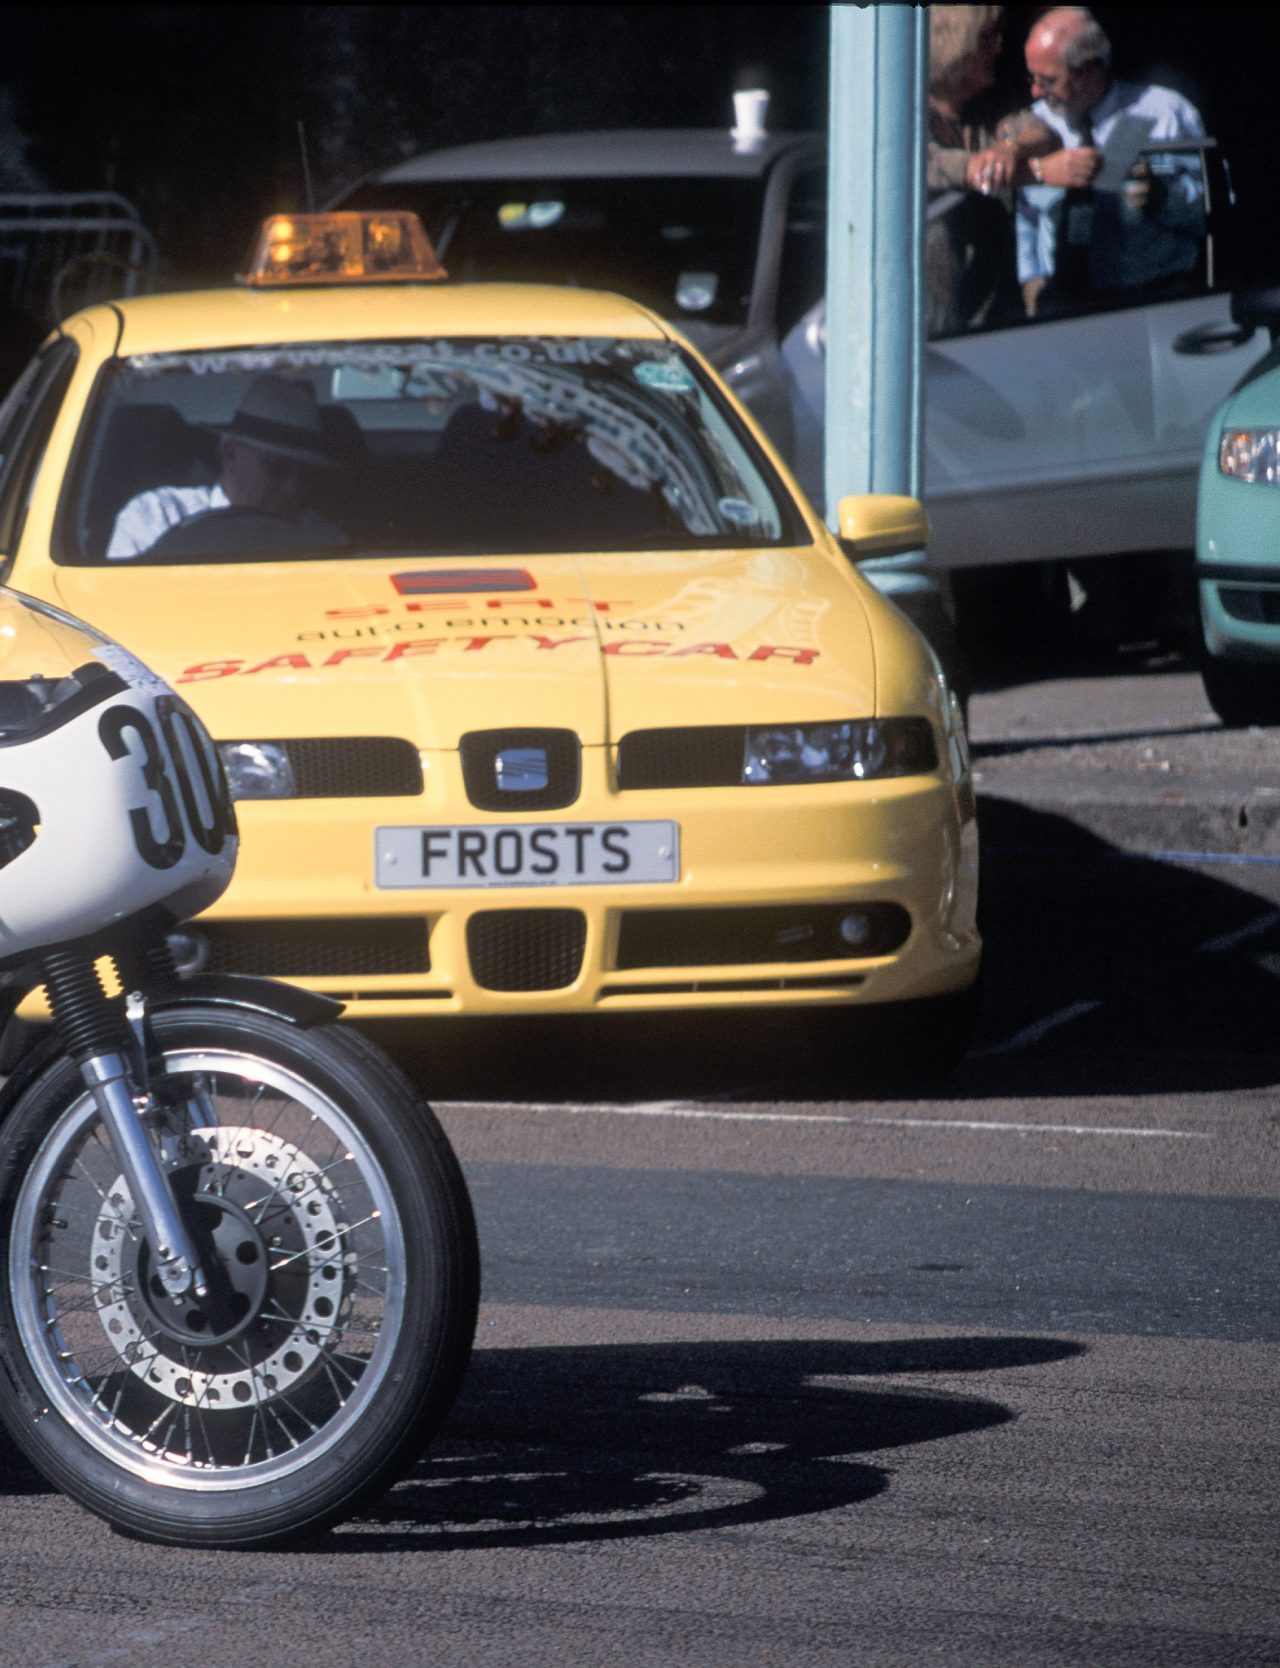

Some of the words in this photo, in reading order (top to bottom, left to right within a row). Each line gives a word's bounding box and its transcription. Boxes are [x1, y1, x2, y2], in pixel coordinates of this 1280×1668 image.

[324, 598, 634, 620] SEAT
[296, 620, 424, 641] auto
[176, 634, 596, 683] SAFETY
[600, 639, 821, 665] CAR
[421, 826, 631, 877] FROSTS
